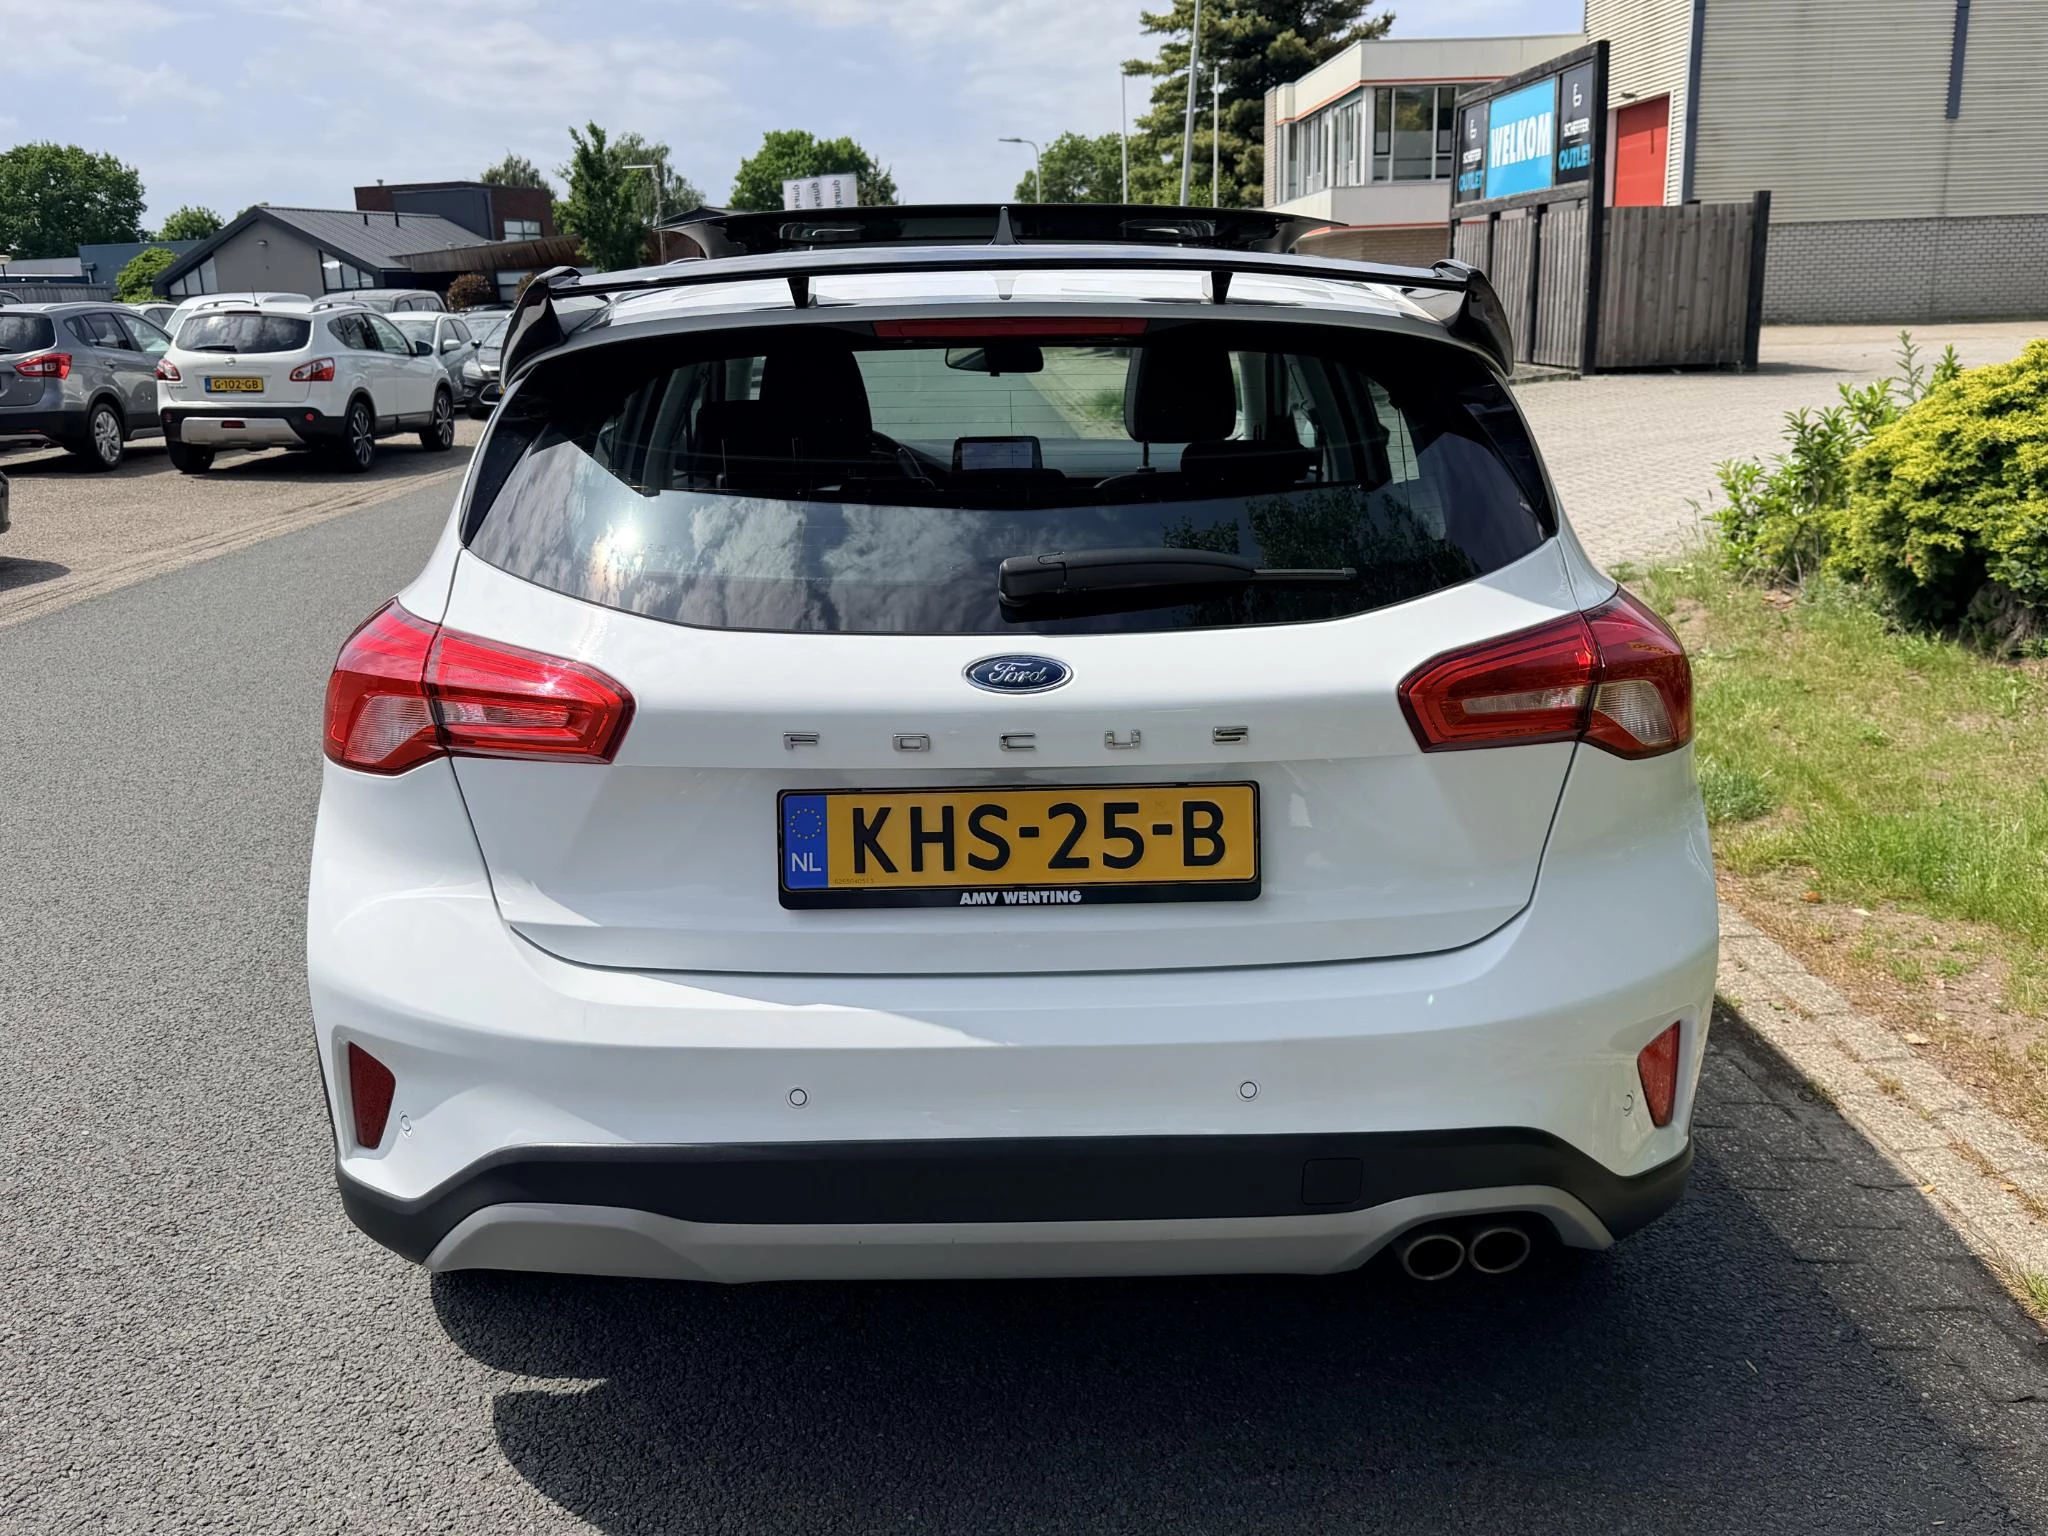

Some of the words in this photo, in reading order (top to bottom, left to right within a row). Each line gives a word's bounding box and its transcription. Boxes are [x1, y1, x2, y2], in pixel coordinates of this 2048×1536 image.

[1491, 112, 1552, 168] WELKOM
[1558, 144, 1591, 171] OUTLET
[1459, 171, 1484, 192] OUTLET
[214, 379, 259, 389] G-102-GB
[988, 662, 1047, 683] Ford
[783, 726, 1249, 751] FOCUS
[852, 801, 1226, 874] KHS-25-B
[791, 852, 821, 872] NL
[960, 892, 998, 905] AMV
[1003, 890, 1082, 904] WENTING
